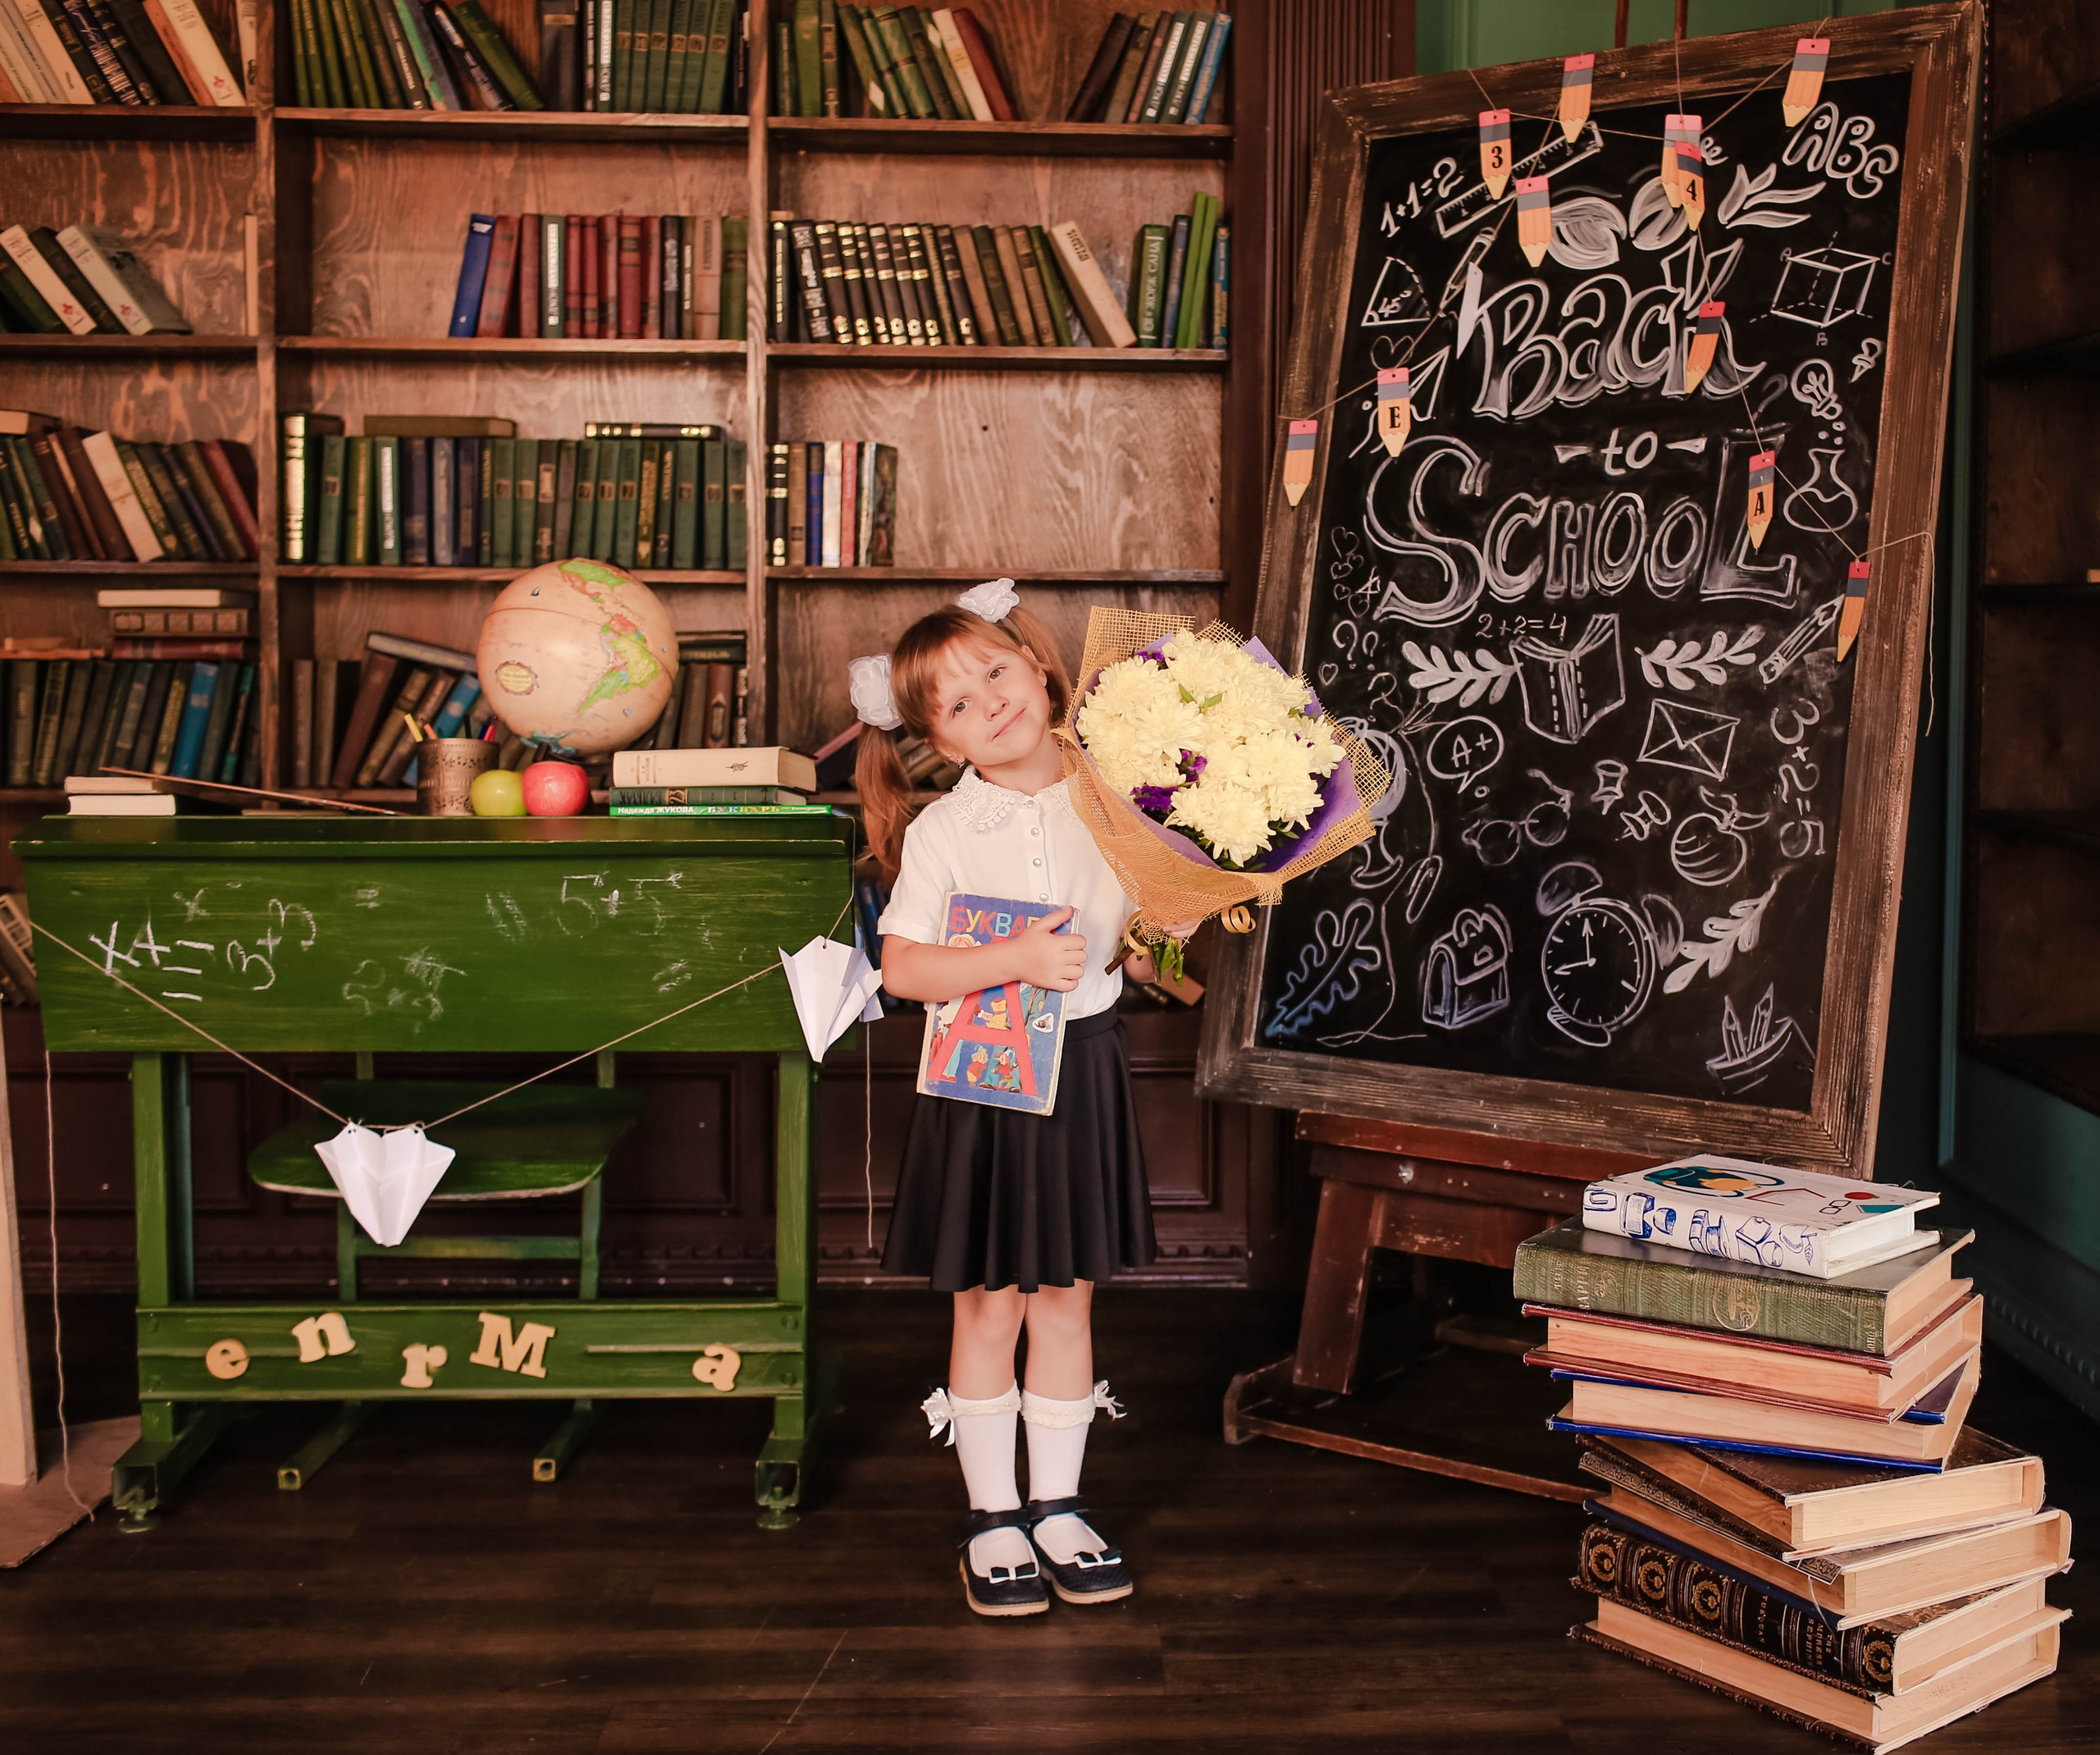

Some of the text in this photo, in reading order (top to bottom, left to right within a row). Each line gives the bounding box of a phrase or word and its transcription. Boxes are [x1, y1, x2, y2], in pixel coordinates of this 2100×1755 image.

[1491, 145, 1504, 169] 3
[1381, 157, 1464, 238] 1+1=2
[1686, 179, 1697, 202] 4
[1388, 406, 1401, 429] E
[1753, 491, 1765, 517] A
[1451, 734, 1494, 769] A+
[656, 806, 695, 814] ЖУКОВА
[952, 907, 1040, 938] БУКВА
[469, 1312, 556, 1378] M
[692, 1341, 741, 1392] a
[1815, 1623, 1824, 1666] MPRESS
